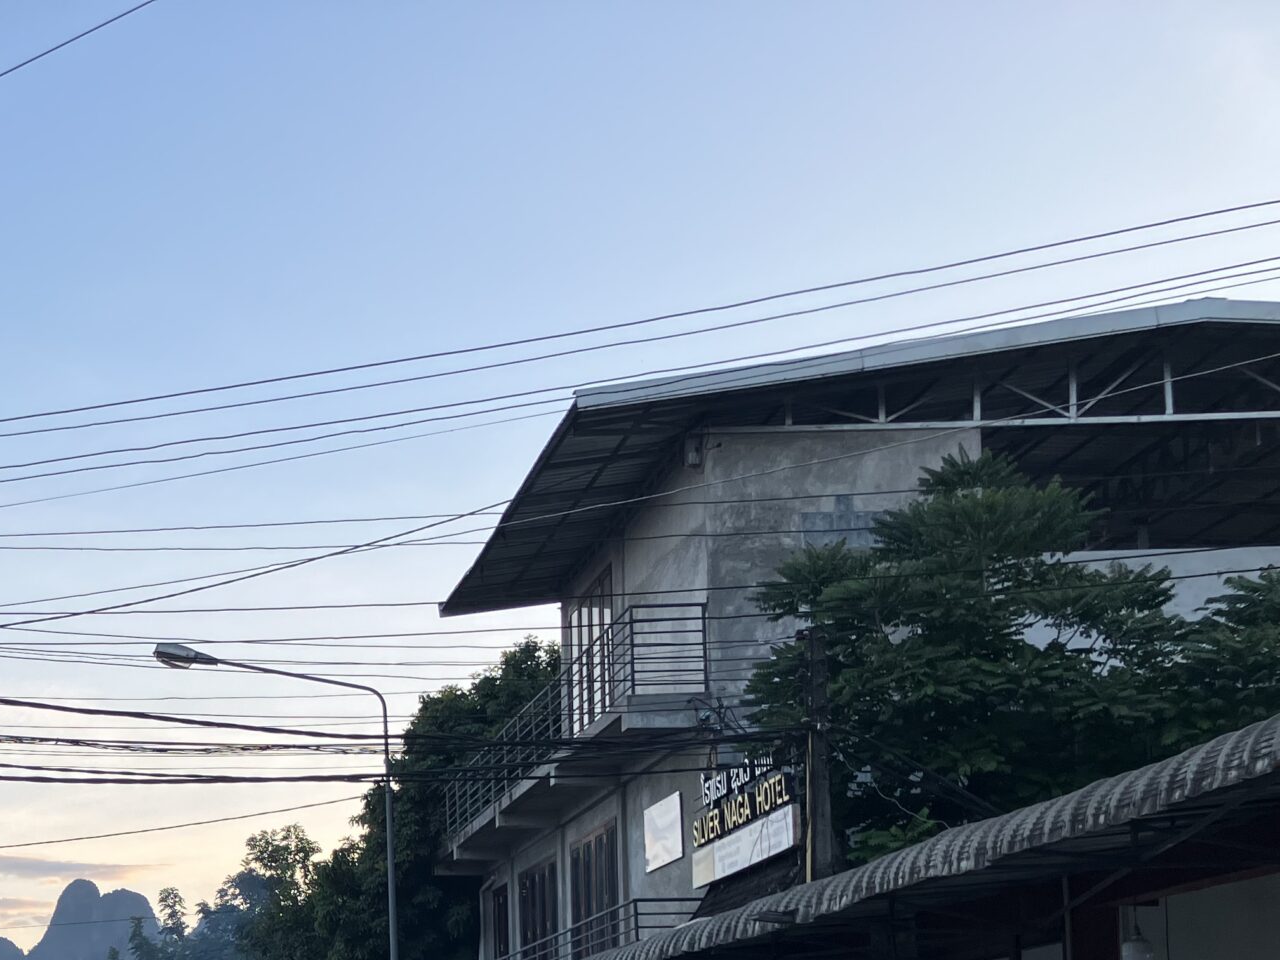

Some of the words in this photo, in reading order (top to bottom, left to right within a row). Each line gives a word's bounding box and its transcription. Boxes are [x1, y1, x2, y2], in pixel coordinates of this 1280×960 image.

[693, 809, 721, 848] SILVER
[724, 793, 751, 832] NAGA
[755, 773, 790, 815] HOTEL
